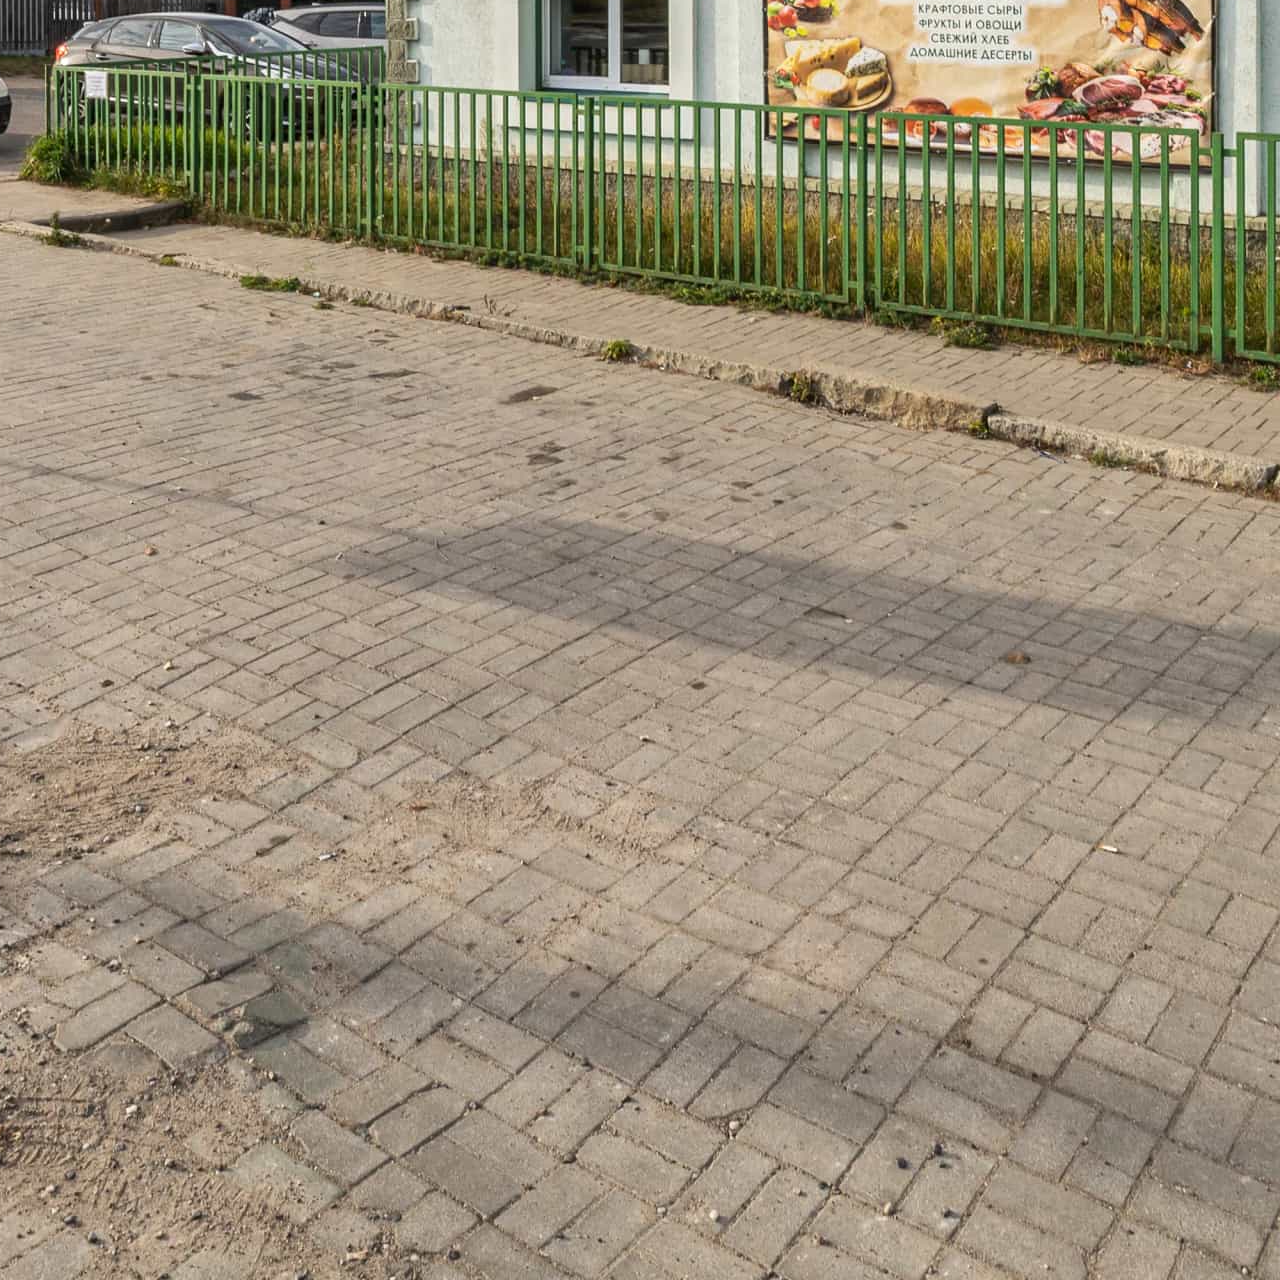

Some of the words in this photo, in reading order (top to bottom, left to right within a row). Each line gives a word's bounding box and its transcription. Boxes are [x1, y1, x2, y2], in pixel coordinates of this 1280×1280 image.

[918, 5, 984, 15] КРАФТОВЫЕ
[987, 5, 1022, 15] СЫРЫ
[918, 19, 961, 29] ФРУКТЫ
[964, 20, 972, 29] И
[975, 20, 1022, 32] ОВОЩИ
[930, 32, 978, 44] СВЕЖИЙ
[981, 35, 1010, 45] ХЛЕБ
[910, 47, 978, 58] ДОМАШНИЕ
[980, 49, 1032, 61] ДЕСЕРТЫ
